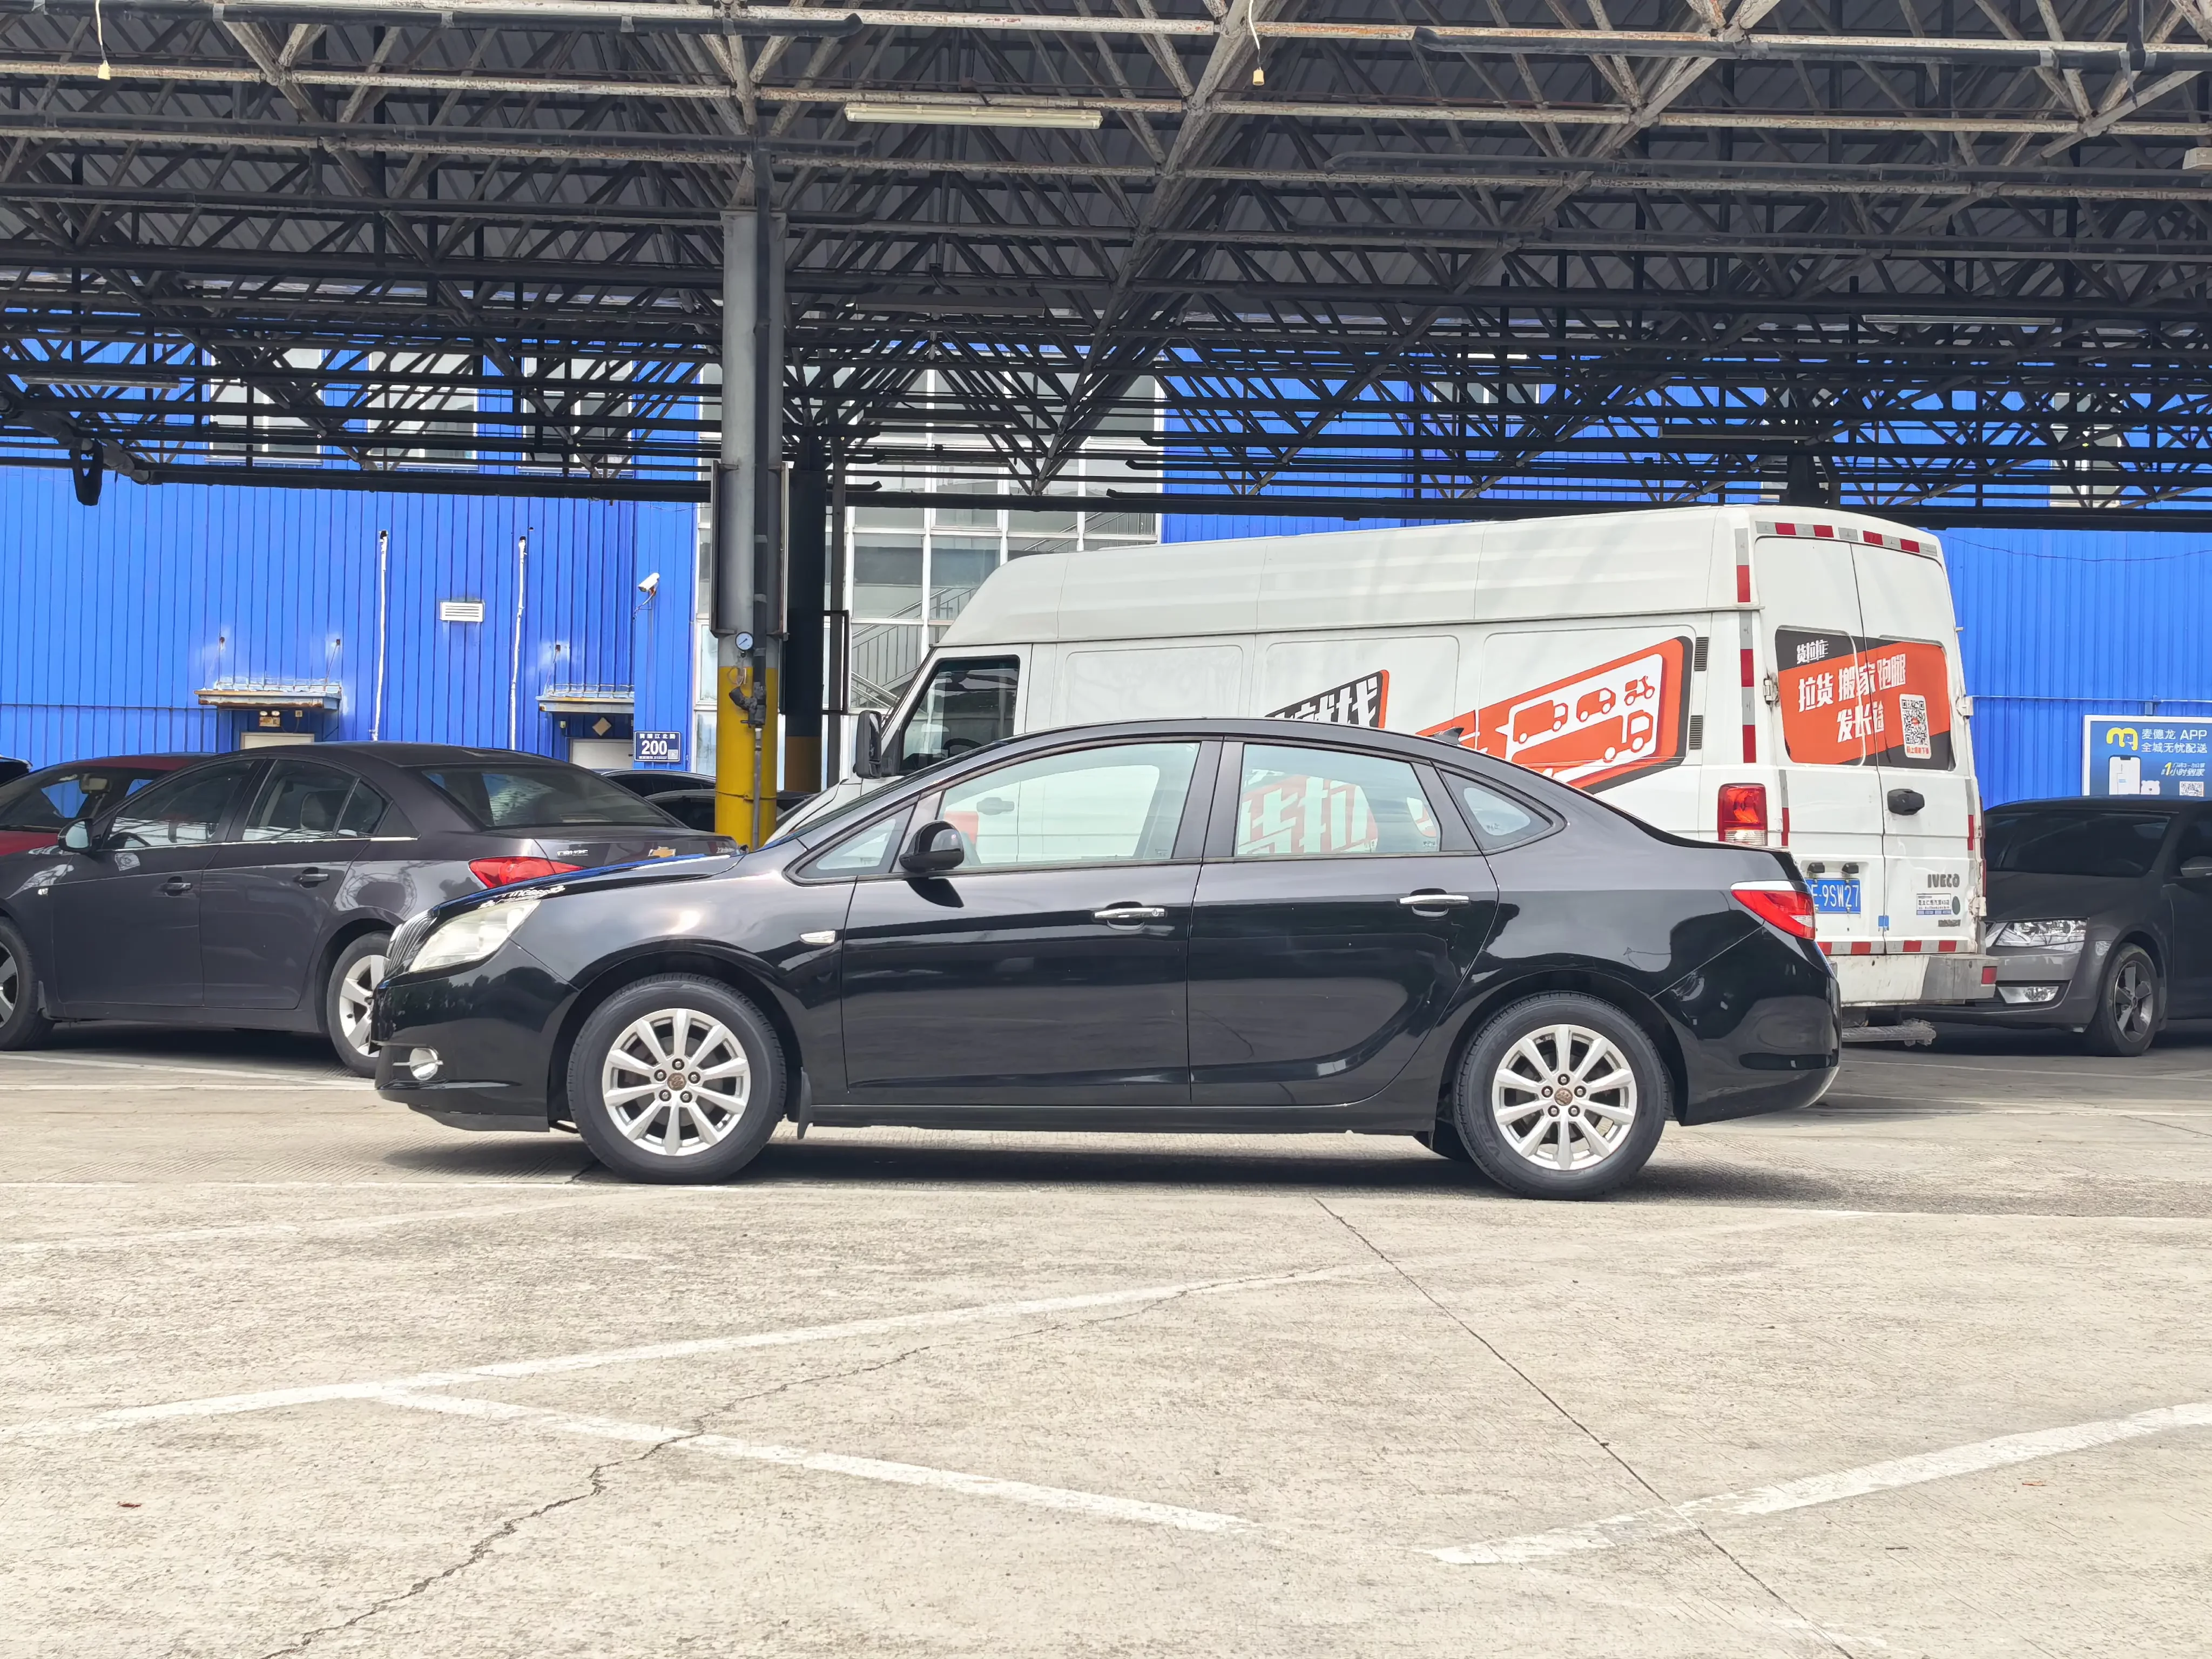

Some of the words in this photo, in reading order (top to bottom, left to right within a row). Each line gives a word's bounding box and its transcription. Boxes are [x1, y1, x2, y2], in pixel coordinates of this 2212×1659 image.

[1797, 639, 1829, 664] 货拉拉
[1798, 672, 1834, 712] 拉货
[1838, 662, 1877, 702] 搬家
[1877, 653, 1906, 690] 跑腿
[2141, 729, 2176, 740] 麦德龙
[2180, 729, 2208, 740] APP
[641, 740, 667, 755] 200
[2141, 742, 2208, 753] 全城无忧配送
[1927, 873, 1960, 888] IVECO
